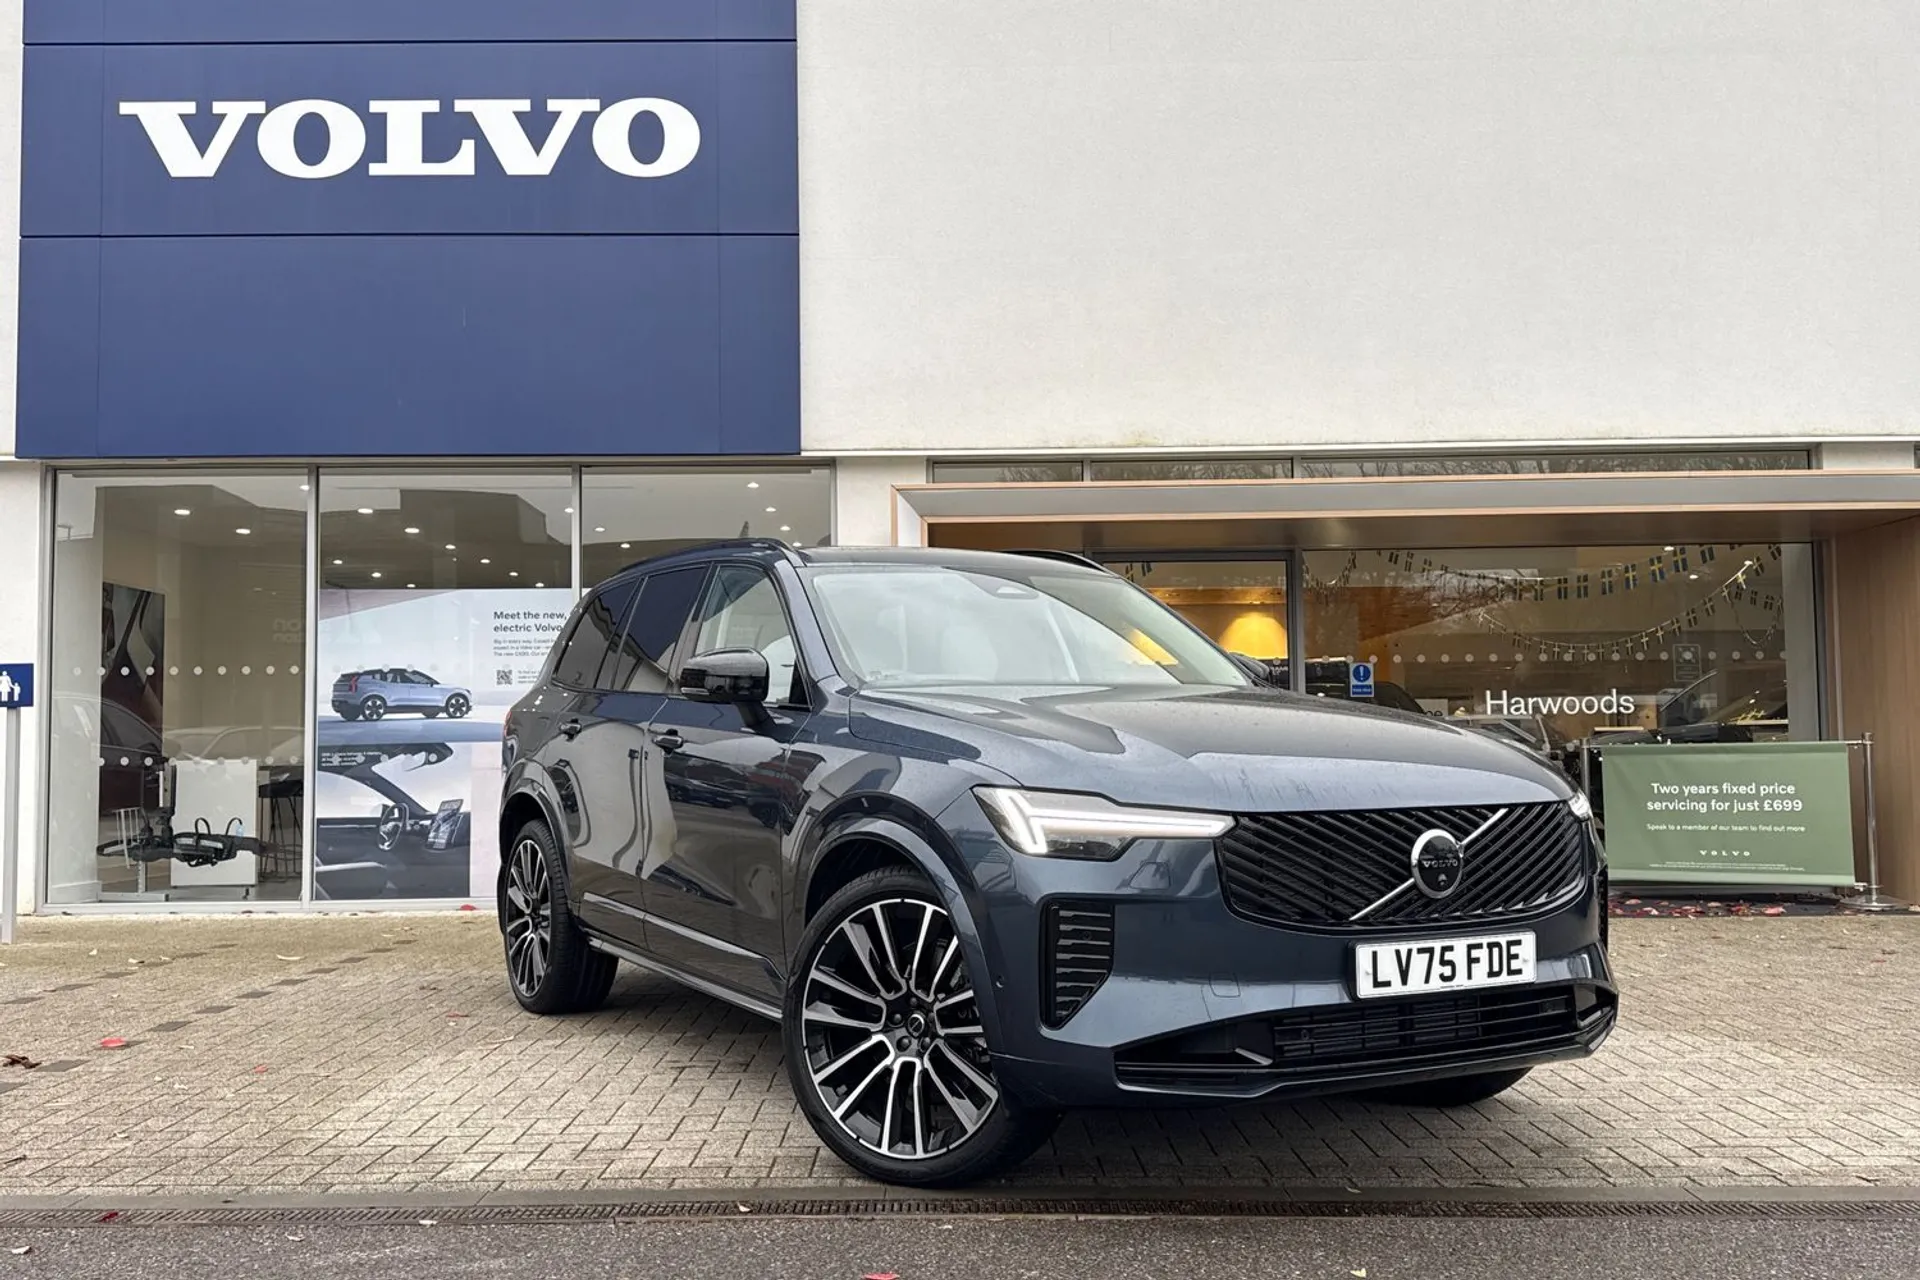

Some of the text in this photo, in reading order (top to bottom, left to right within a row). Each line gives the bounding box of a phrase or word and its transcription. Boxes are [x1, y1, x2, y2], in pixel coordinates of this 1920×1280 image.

[119, 97, 701, 179] VOLVO
[493, 611, 567, 621] Meet the new,
[493, 623, 562, 633] electric Volvo
[1485, 688, 1635, 716] Harwoods
[1650, 782, 1796, 797] Two years fixed price
[1646, 799, 1803, 813] servicing for just £699
[1646, 823, 1667, 831] Speak
[1667, 823, 1676, 831] to
[1681, 823, 1710, 831] member
[1731, 824, 1750, 832] team
[1750, 824, 1758, 832] to
[1758, 824, 1773, 832] find
[1786, 825, 1806, 833] more
[1699, 849, 1751, 857] VOLVO
[1422, 858, 1459, 868] VOLVO
[1371, 939, 1523, 989] LV75 FDE
